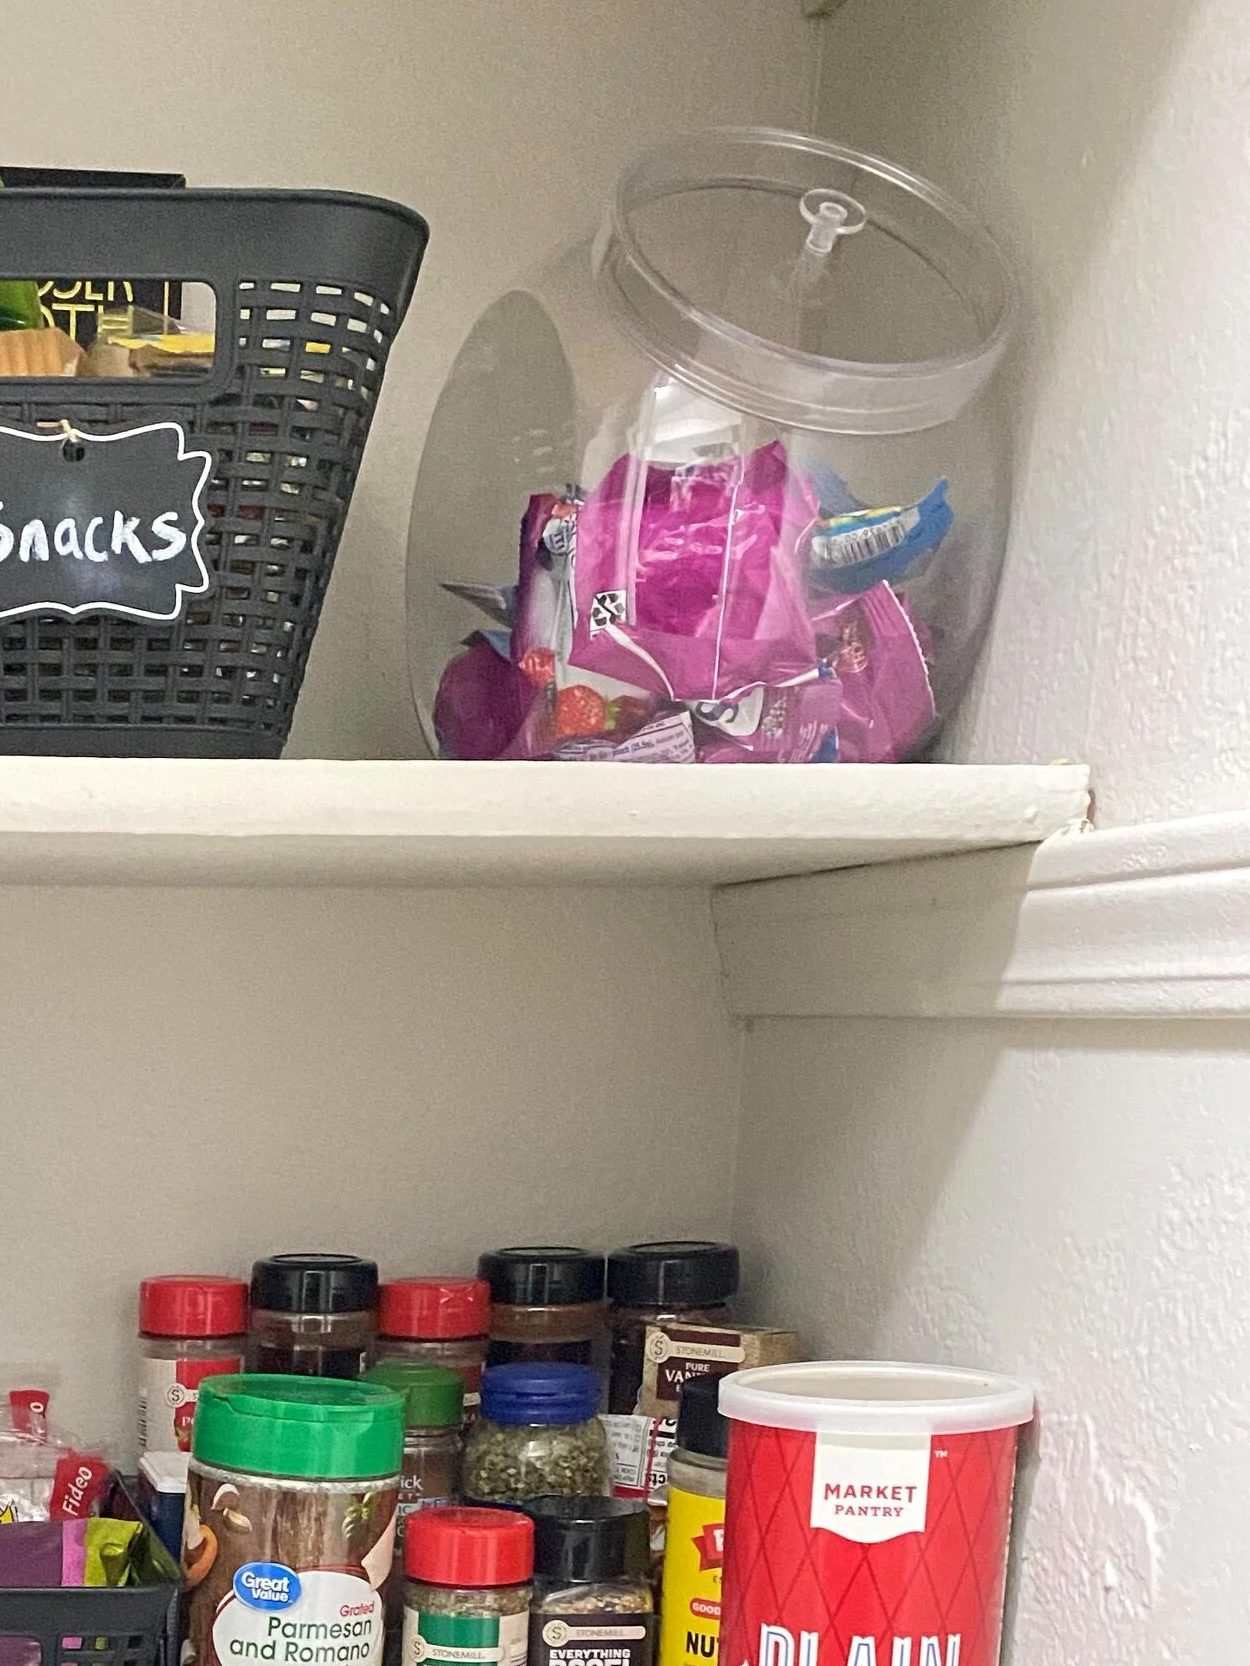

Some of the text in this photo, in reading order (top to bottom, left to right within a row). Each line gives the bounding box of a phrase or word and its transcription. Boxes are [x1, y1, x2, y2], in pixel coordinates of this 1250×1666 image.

[686, 1362, 710, 1373] PURE
[62, 1465, 93, 1518] Fideo
[824, 1483, 918, 1503] MARKET
[834, 1504, 905, 1518] PANTRY
[241, 1571, 290, 1593] Great
[252, 1588, 290, 1603] Value
[340, 1601, 375, 1617] Grated
[268, 1616, 372, 1640] Parmesan
[229, 1639, 370, 1663] and Romano
[686, 1631, 718, 1658] NU
[432, 1649, 485, 1660] STONEMILL
[549, 1649, 631, 1659] EVERYTHING
